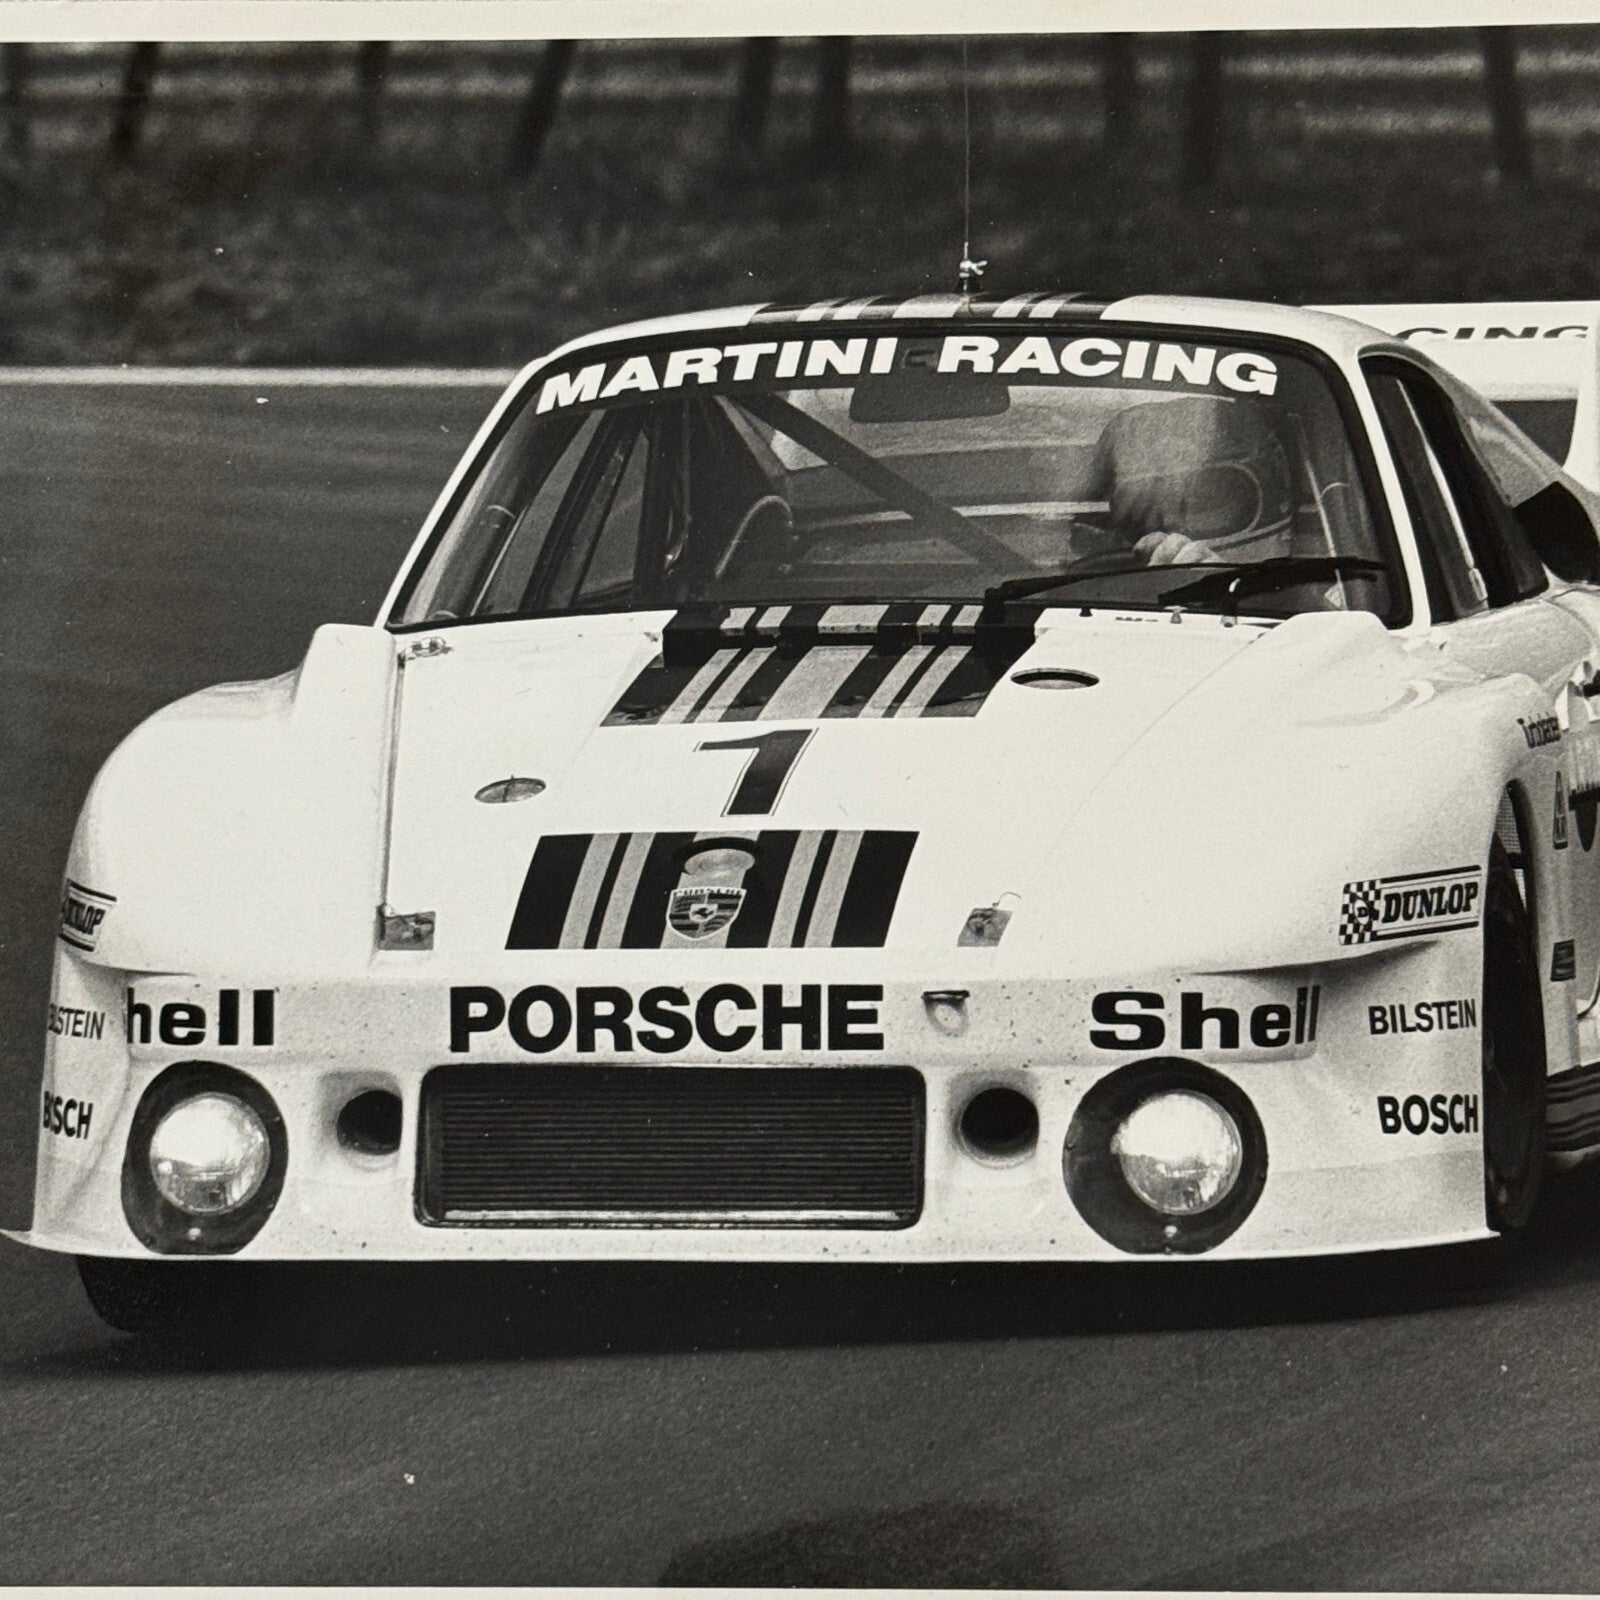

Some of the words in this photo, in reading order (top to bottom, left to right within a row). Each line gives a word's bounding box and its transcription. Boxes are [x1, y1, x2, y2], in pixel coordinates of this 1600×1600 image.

[535, 337, 898, 415] MARTINI
[936, 335, 1278, 396] RACING
[693, 727, 819, 817] 1
[1381, 881, 1479, 924] DUNLOP
[449, 983, 885, 1054] PORSCHE
[1088, 984, 1321, 1051] Shell
[1367, 998, 1478, 1035] BILSTEIN
[1376, 1094, 1479, 1136] BOSCH
